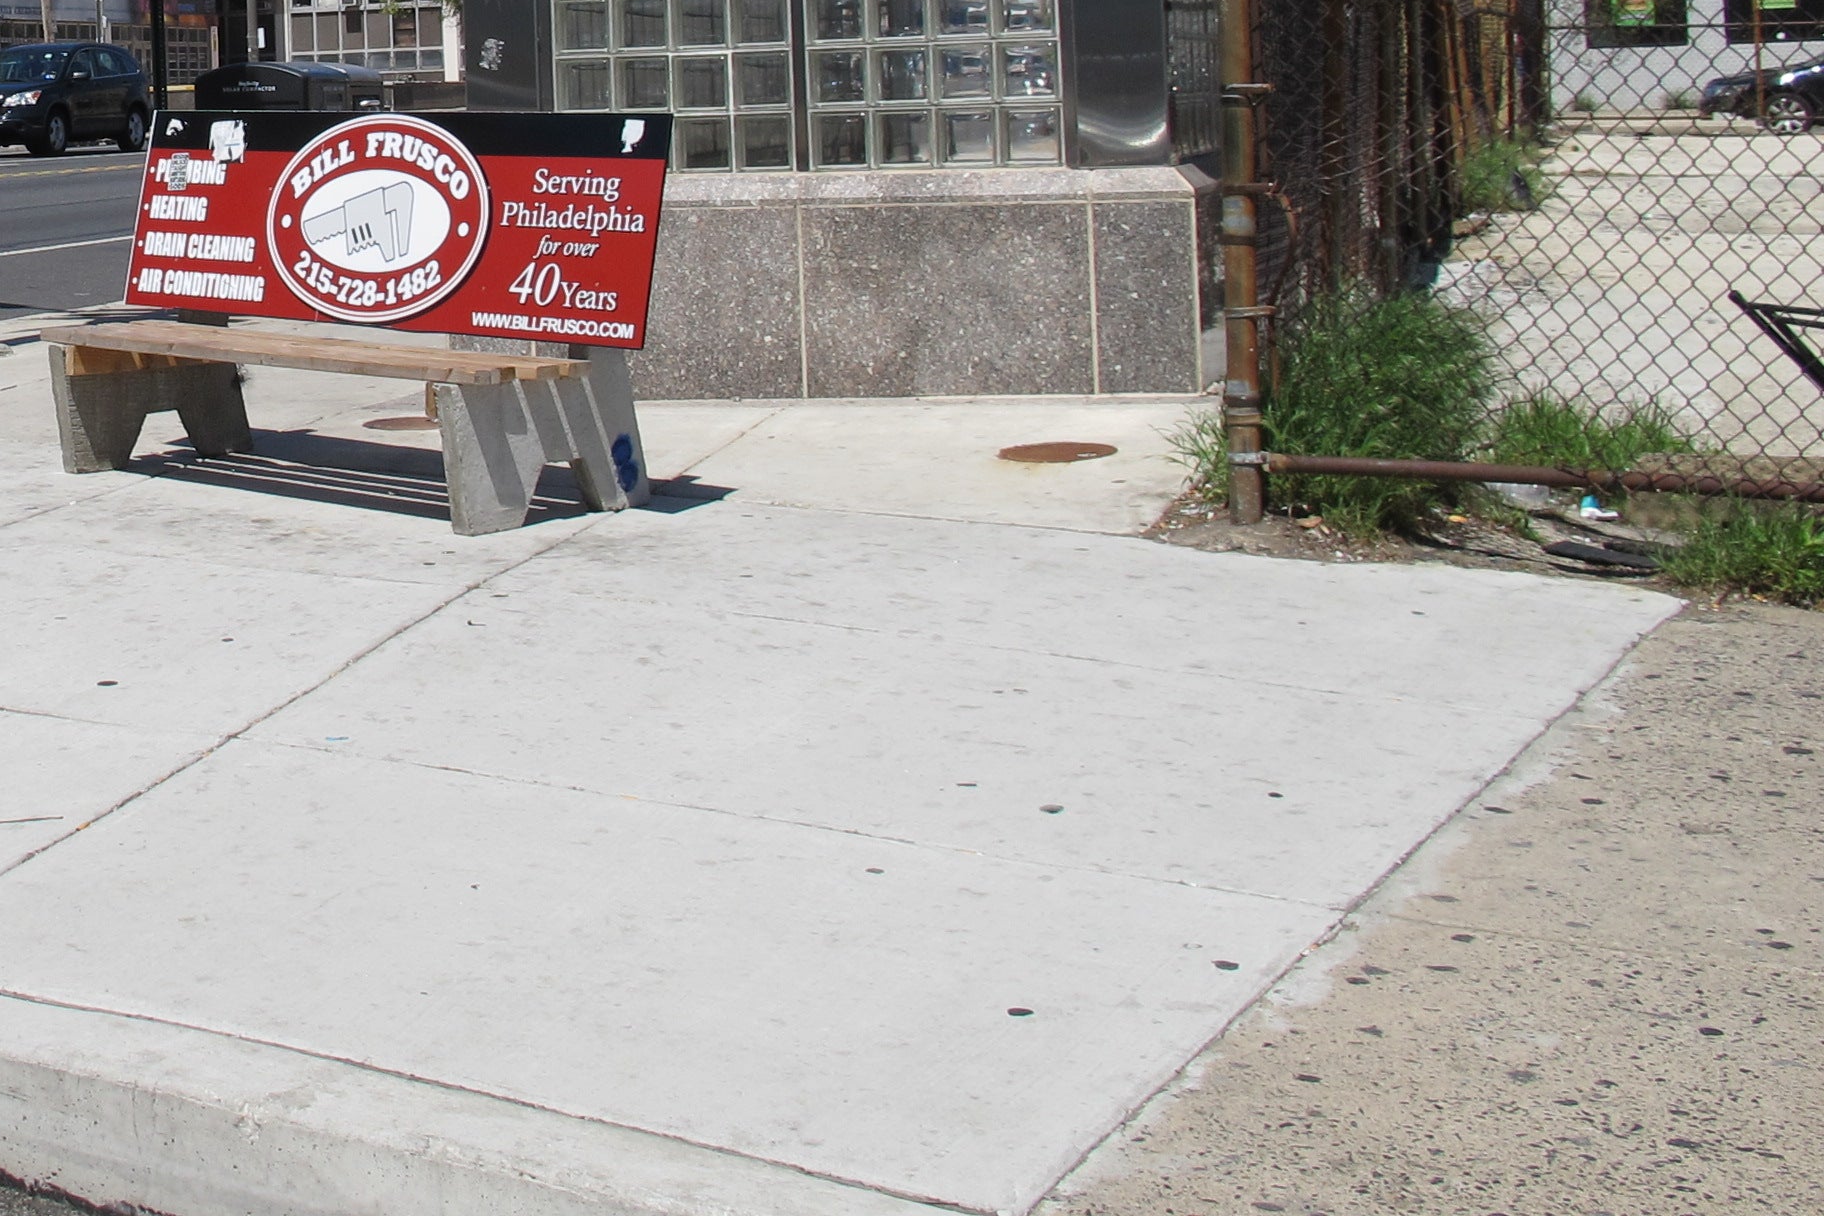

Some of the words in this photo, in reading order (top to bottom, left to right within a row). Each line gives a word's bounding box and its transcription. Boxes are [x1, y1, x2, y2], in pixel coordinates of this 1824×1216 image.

[155, 158, 228, 185] PLBING
[290, 139, 356, 199] BILL
[365, 131, 470, 200] FRUSCO
[532, 168, 621, 202] Serving
[149, 194, 208, 222] HEATING
[500, 201, 645, 237] Philadelphia
[143, 231, 187, 258] DRAIN
[187, 233, 256, 263] CLEANING
[532, 234, 562, 259] for
[563, 242, 599, 257] over
[137, 267, 163, 295] AIR
[163, 269, 265, 302] CONDITIONING
[293, 250, 442, 307] 215-728-1482
[508, 261, 561, 307] 40
[560, 281, 618, 311] Years
[471, 311, 636, 340] WWW.BILLFRUSCO.COM
